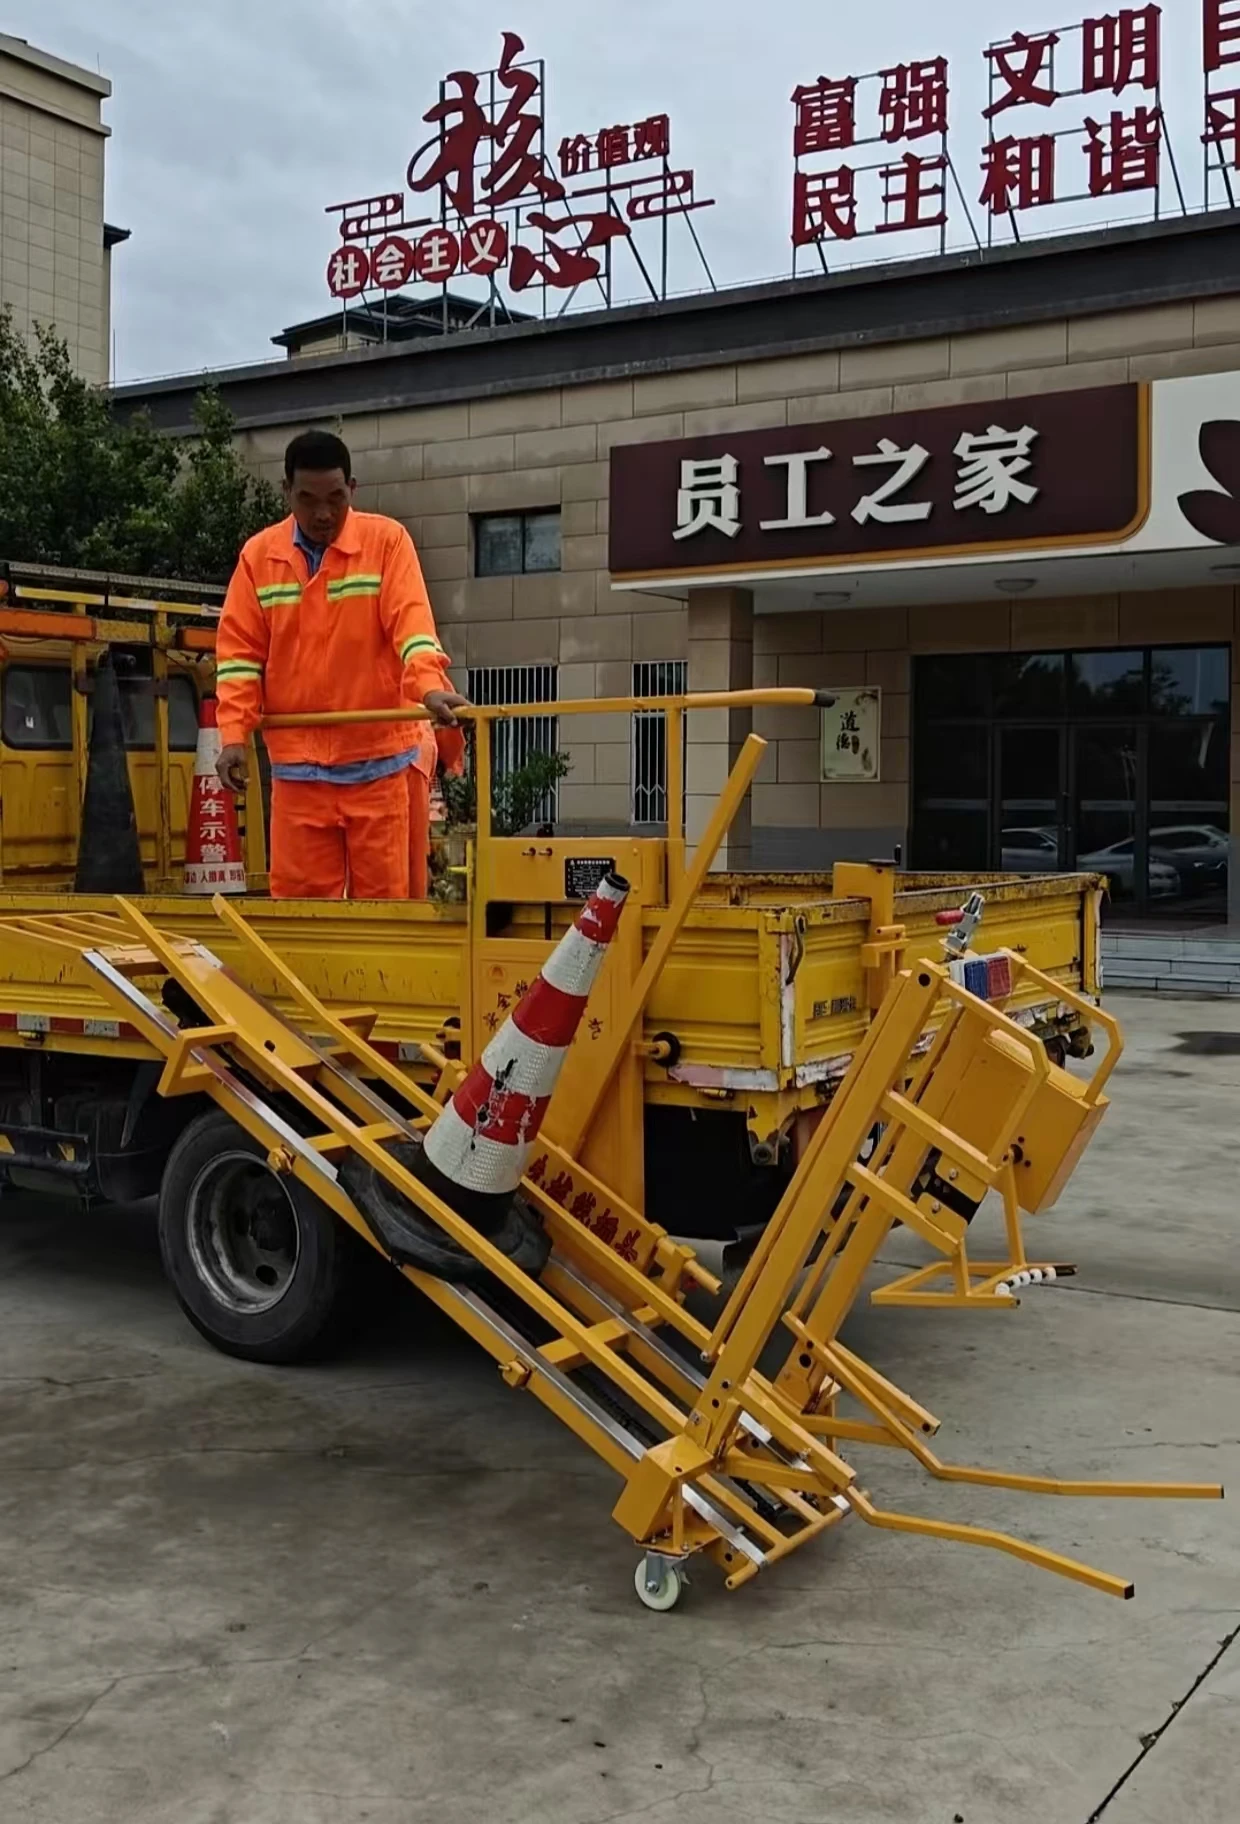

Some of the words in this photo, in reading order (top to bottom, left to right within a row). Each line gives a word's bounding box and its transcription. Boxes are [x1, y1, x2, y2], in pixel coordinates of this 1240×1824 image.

[791, 56, 949, 157] 富强
[981, 3, 1162, 118] 文明
[557, 114, 669, 178] 价值观
[791, 152, 948, 248] 民主
[979, 106, 1163, 216] 和谐
[331, 226, 499, 292] 社会主义
[672, 425, 1039, 541] 员工之家
[199, 776, 227, 863] 停车示警
